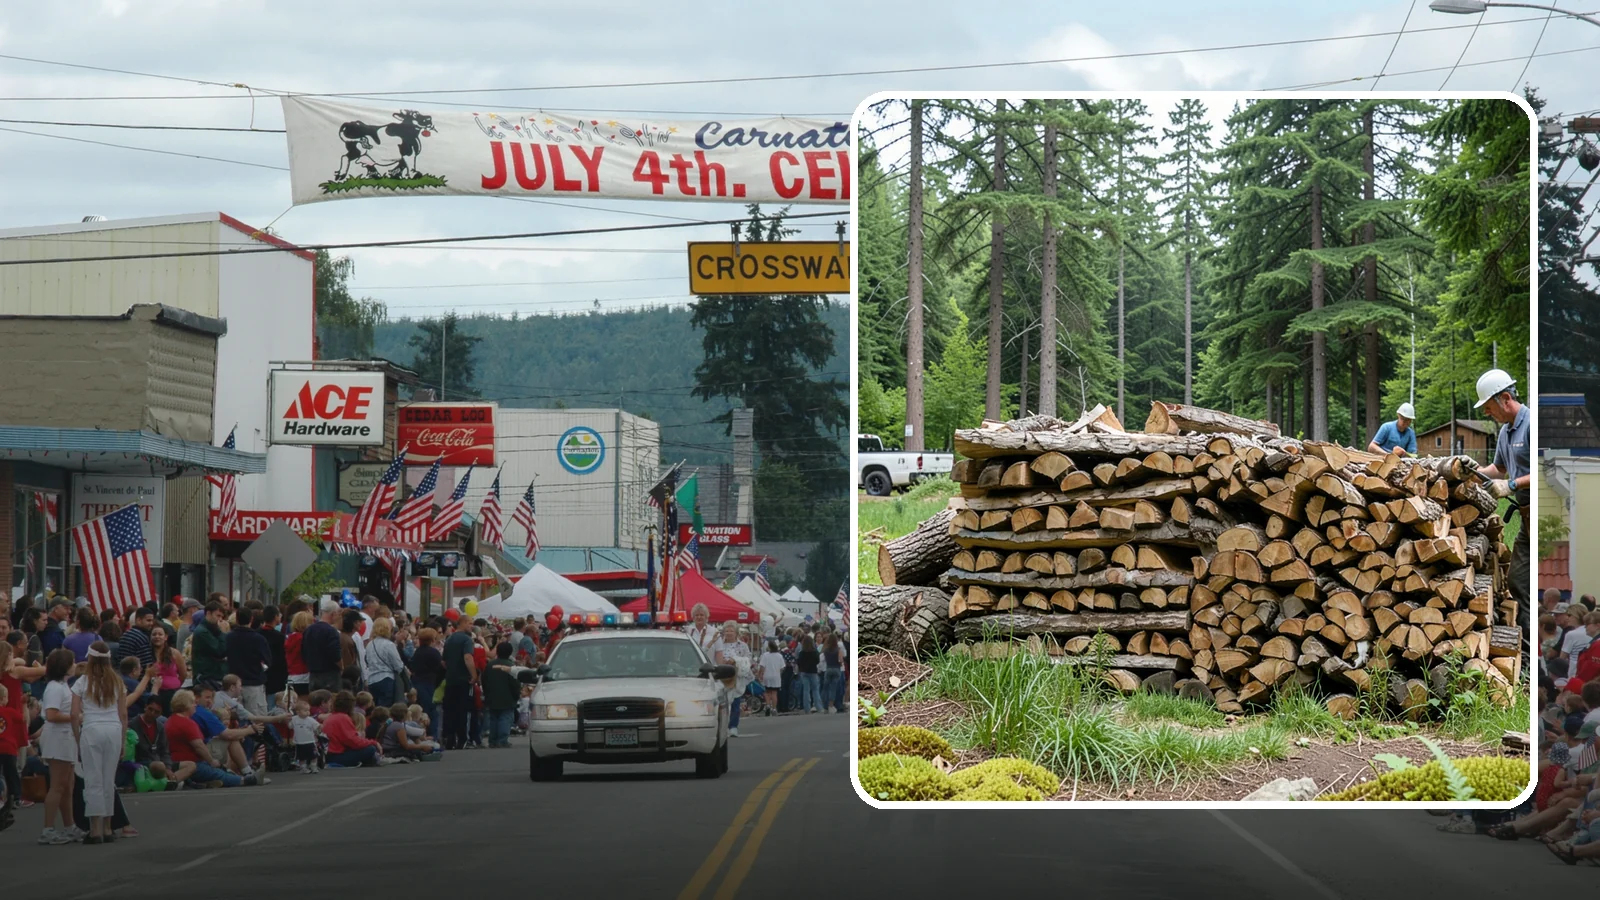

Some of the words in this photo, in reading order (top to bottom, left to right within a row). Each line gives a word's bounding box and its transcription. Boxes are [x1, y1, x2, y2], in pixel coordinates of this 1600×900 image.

[481, 140, 606, 193] JULY
[632, 150, 747, 198] 4th.
[697, 254, 850, 281] CROSSWA
[282, 380, 374, 420] ACE
[405, 409, 453, 422] CEDAR
[283, 420, 371, 437] Hardware
[416, 427, 477, 448] Coca-Cola
[353, 467, 386, 480] Simpl
[95, 485, 125, 495] Vincent
[126, 486, 136, 495] de
[137, 486, 155, 496] Paul
[688, 526, 742, 535] CRNATION
[698, 535, 731, 543] GLASS
